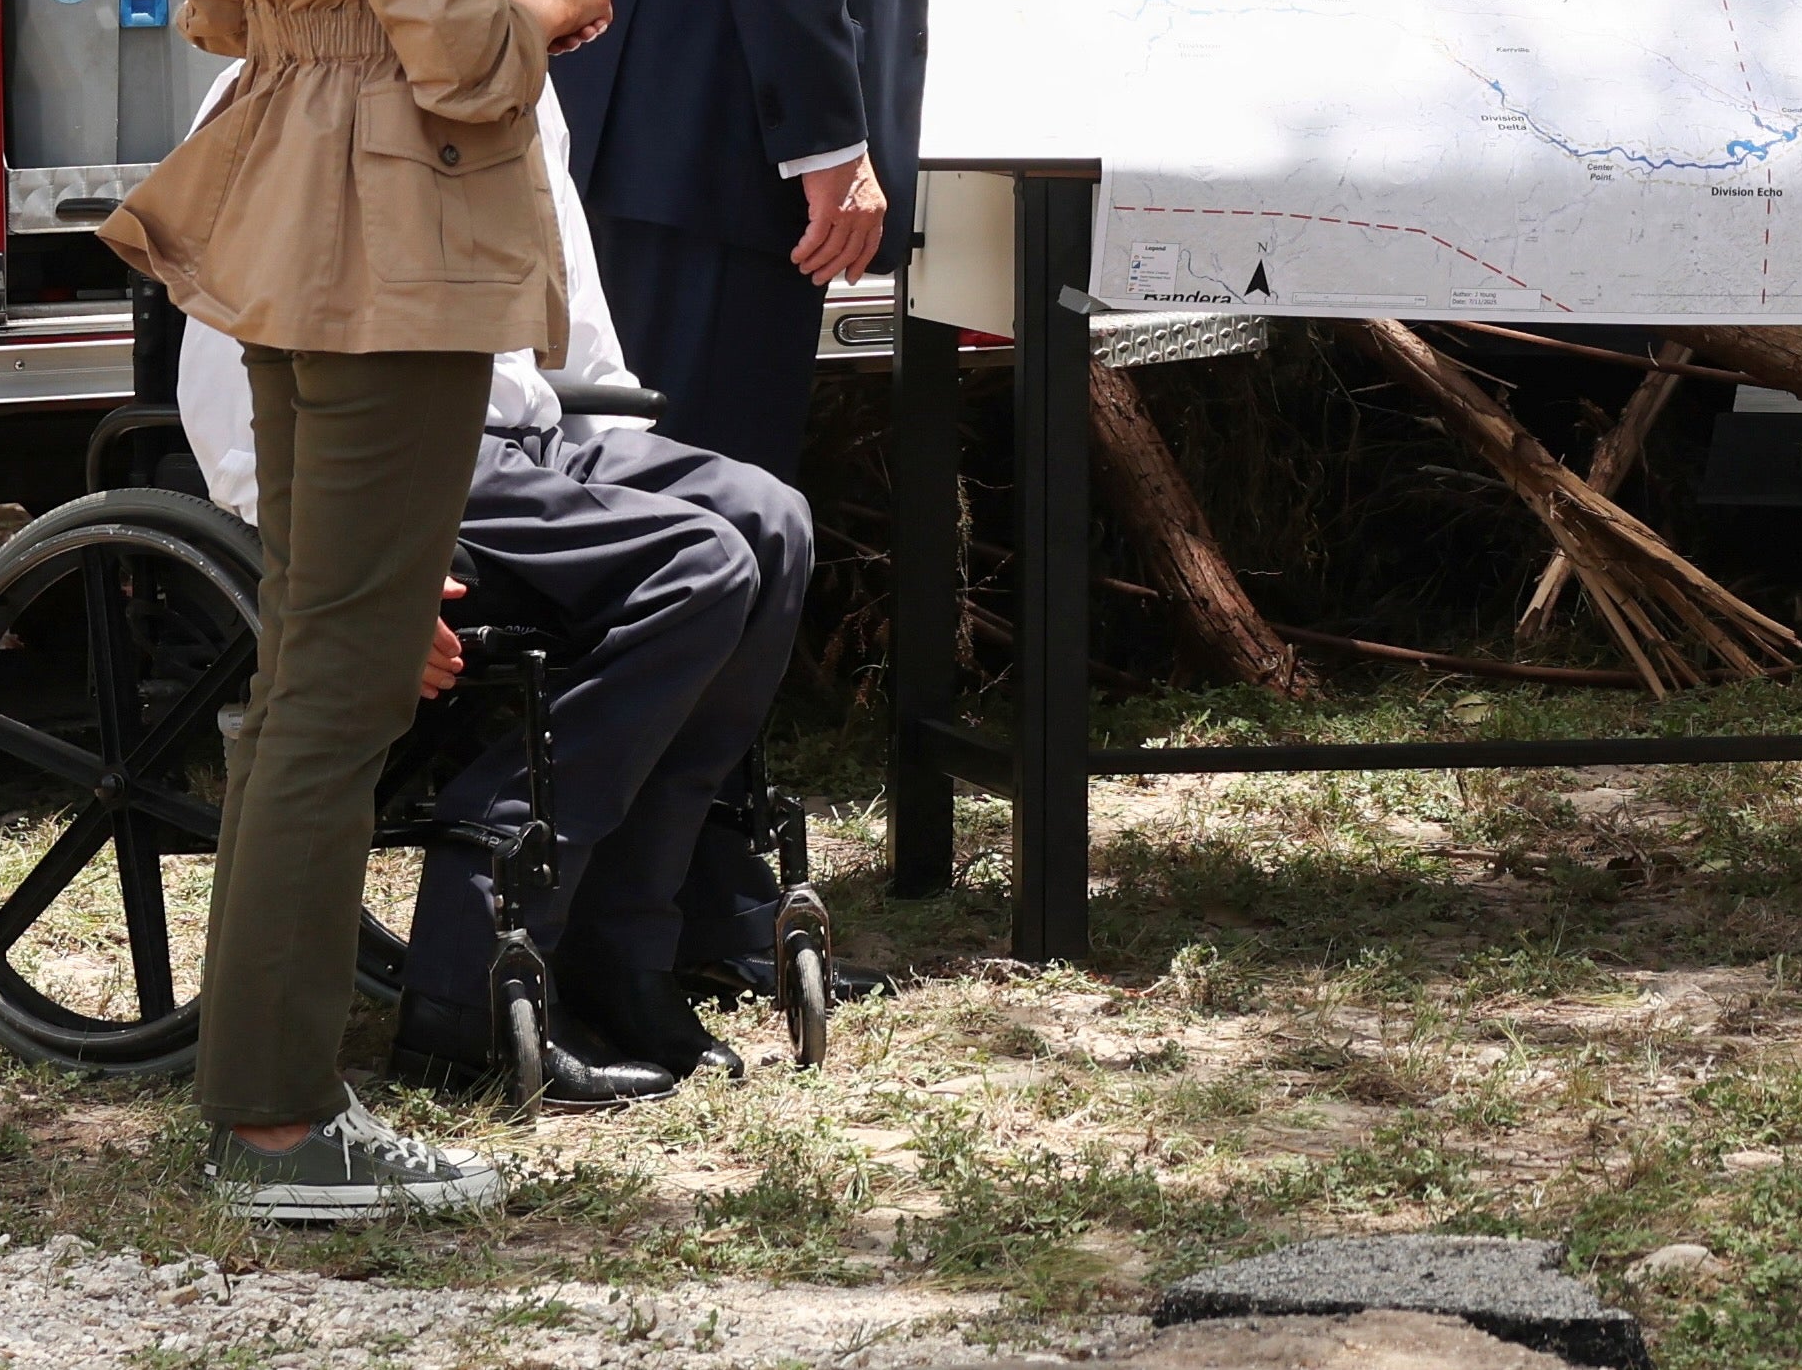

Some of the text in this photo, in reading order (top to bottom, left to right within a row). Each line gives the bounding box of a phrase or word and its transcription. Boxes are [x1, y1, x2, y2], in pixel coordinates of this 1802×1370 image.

[1481, 115, 1525, 123] Division
[1498, 123, 1527, 131] Delta
[1587, 163, 1614, 171] Center
[1711, 187, 1783, 197] Division Echo
[1257, 242, 1268, 253] N
